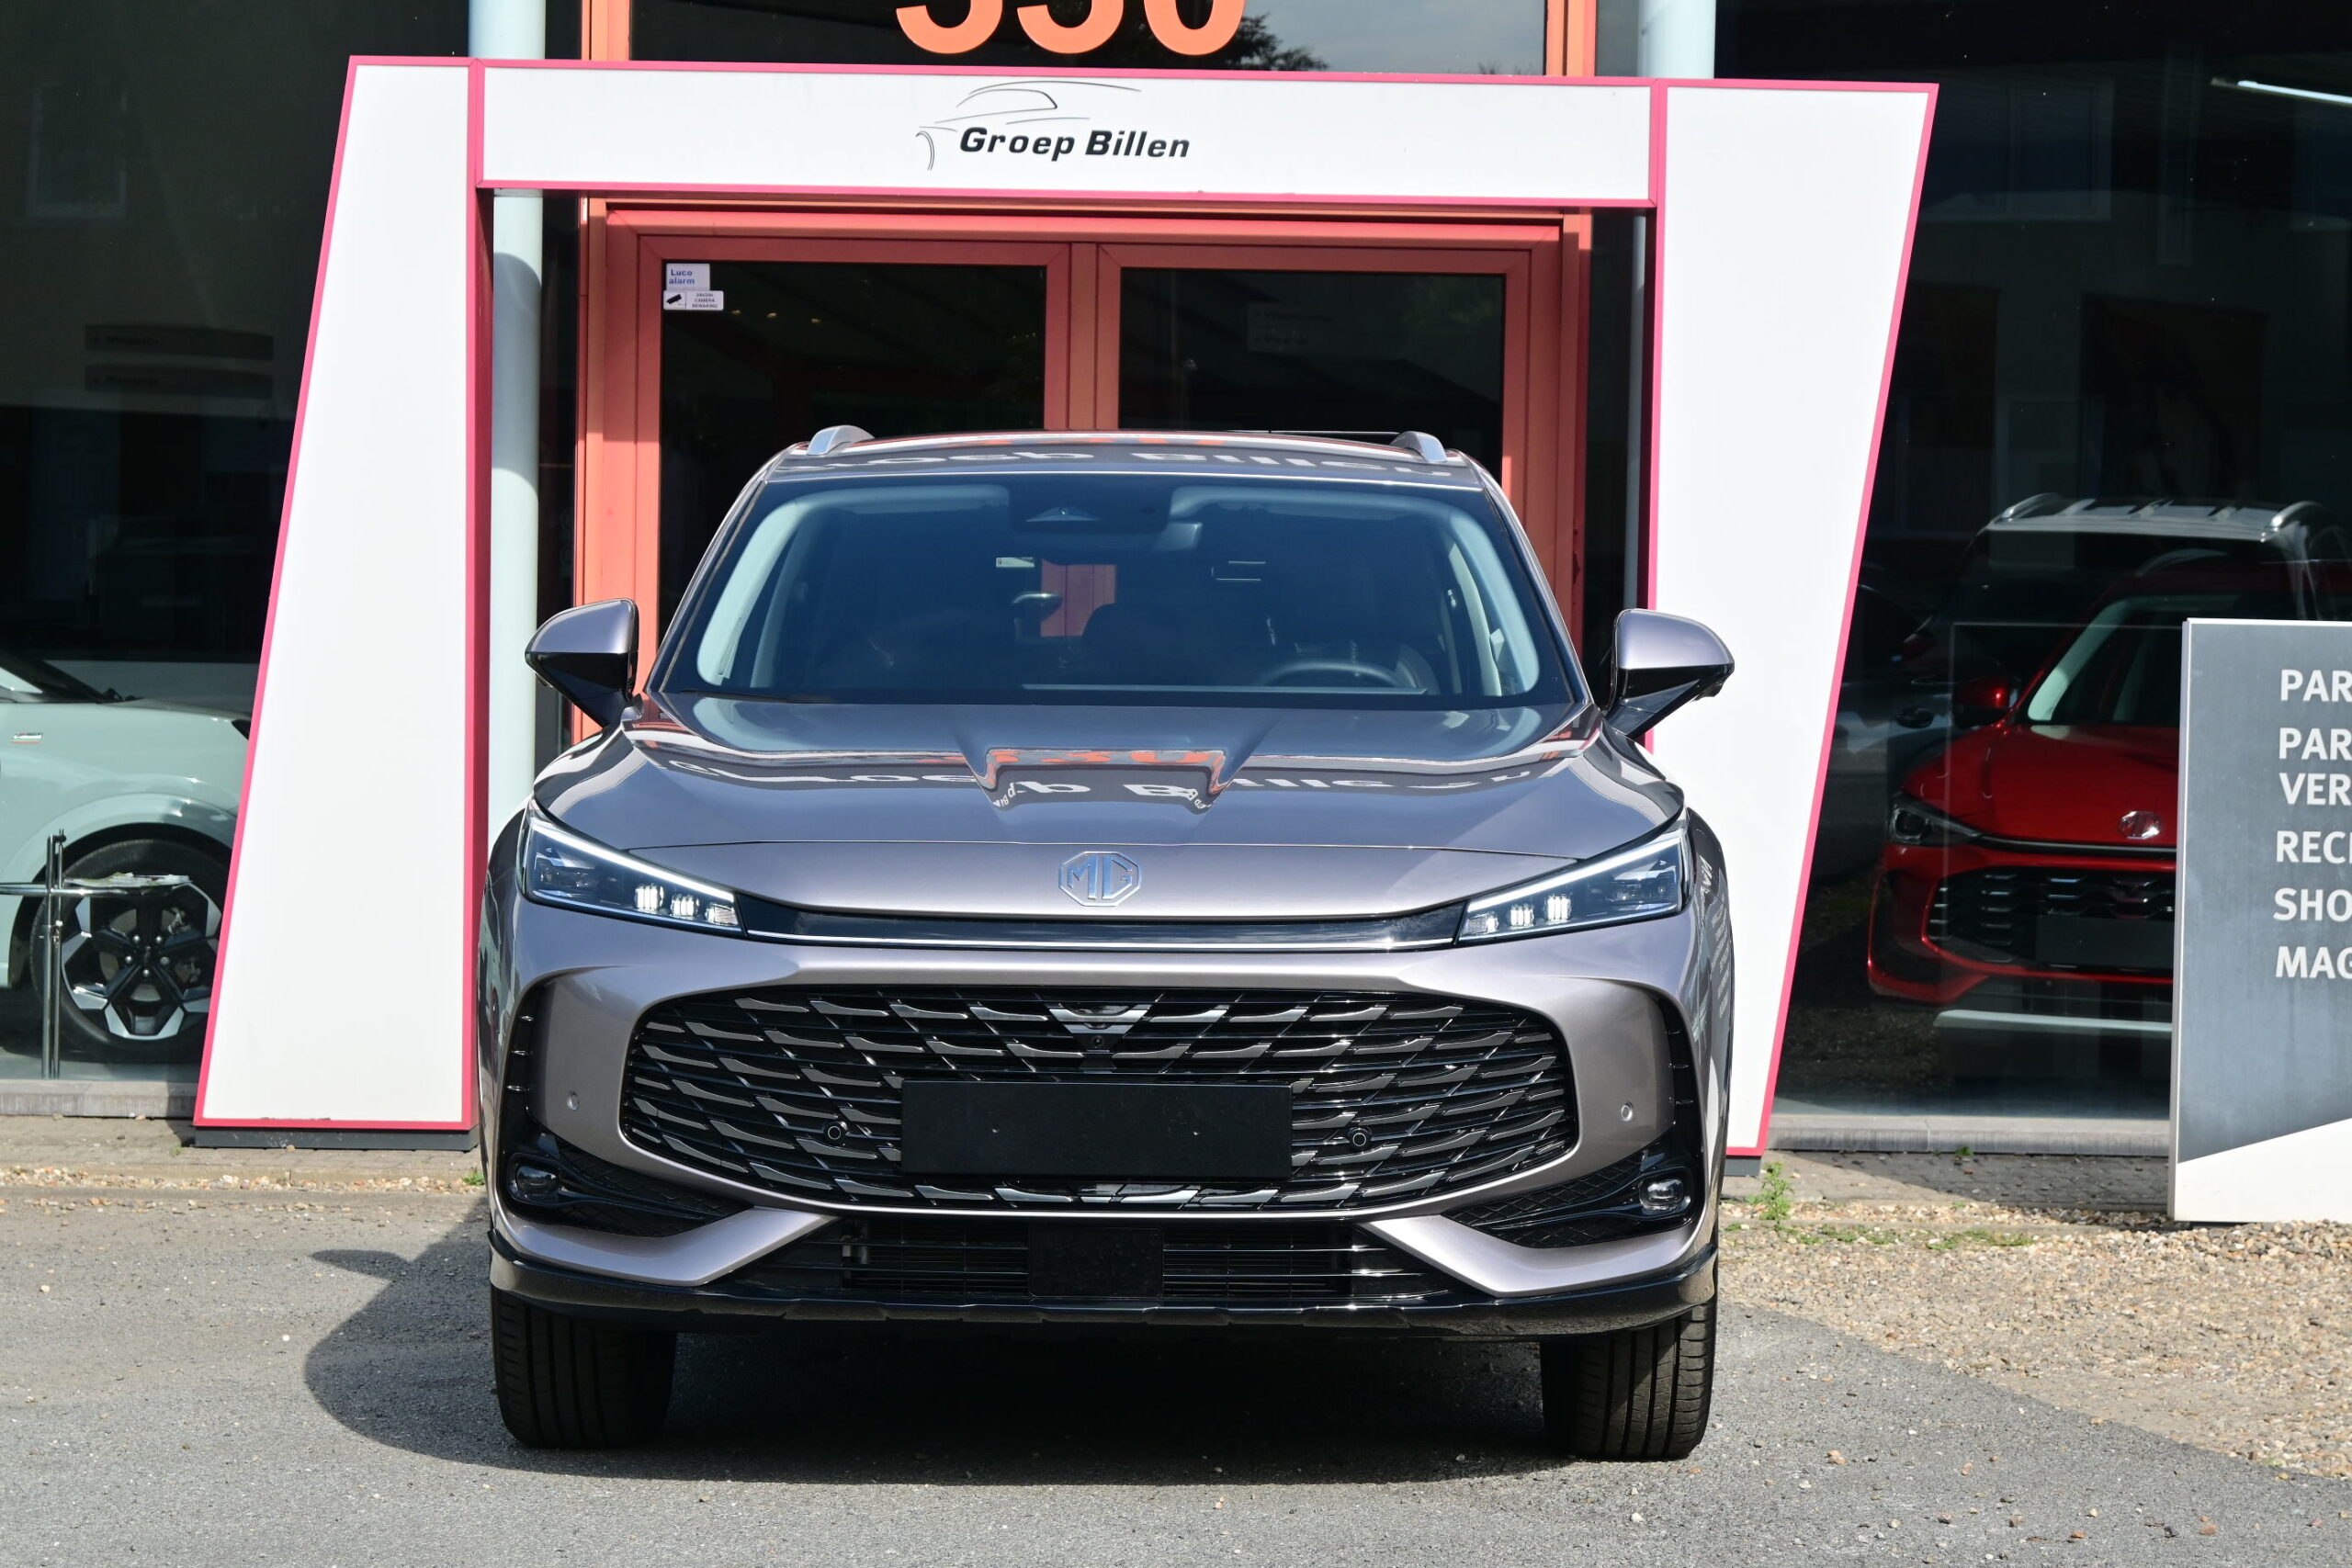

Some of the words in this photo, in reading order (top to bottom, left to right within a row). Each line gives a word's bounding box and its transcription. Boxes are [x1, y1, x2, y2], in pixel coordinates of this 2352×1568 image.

[960, 127, 1075, 162] Groep
[1085, 130, 1190, 158] Billen
[671, 268, 693, 276] Luco
[2280, 669, 2352, 703] PAR
[2278, 727, 2352, 761] PAR
[2278, 772, 2352, 807] VER
[1067, 854, 1133, 900] MG
[2272, 886, 2352, 922] SHO
